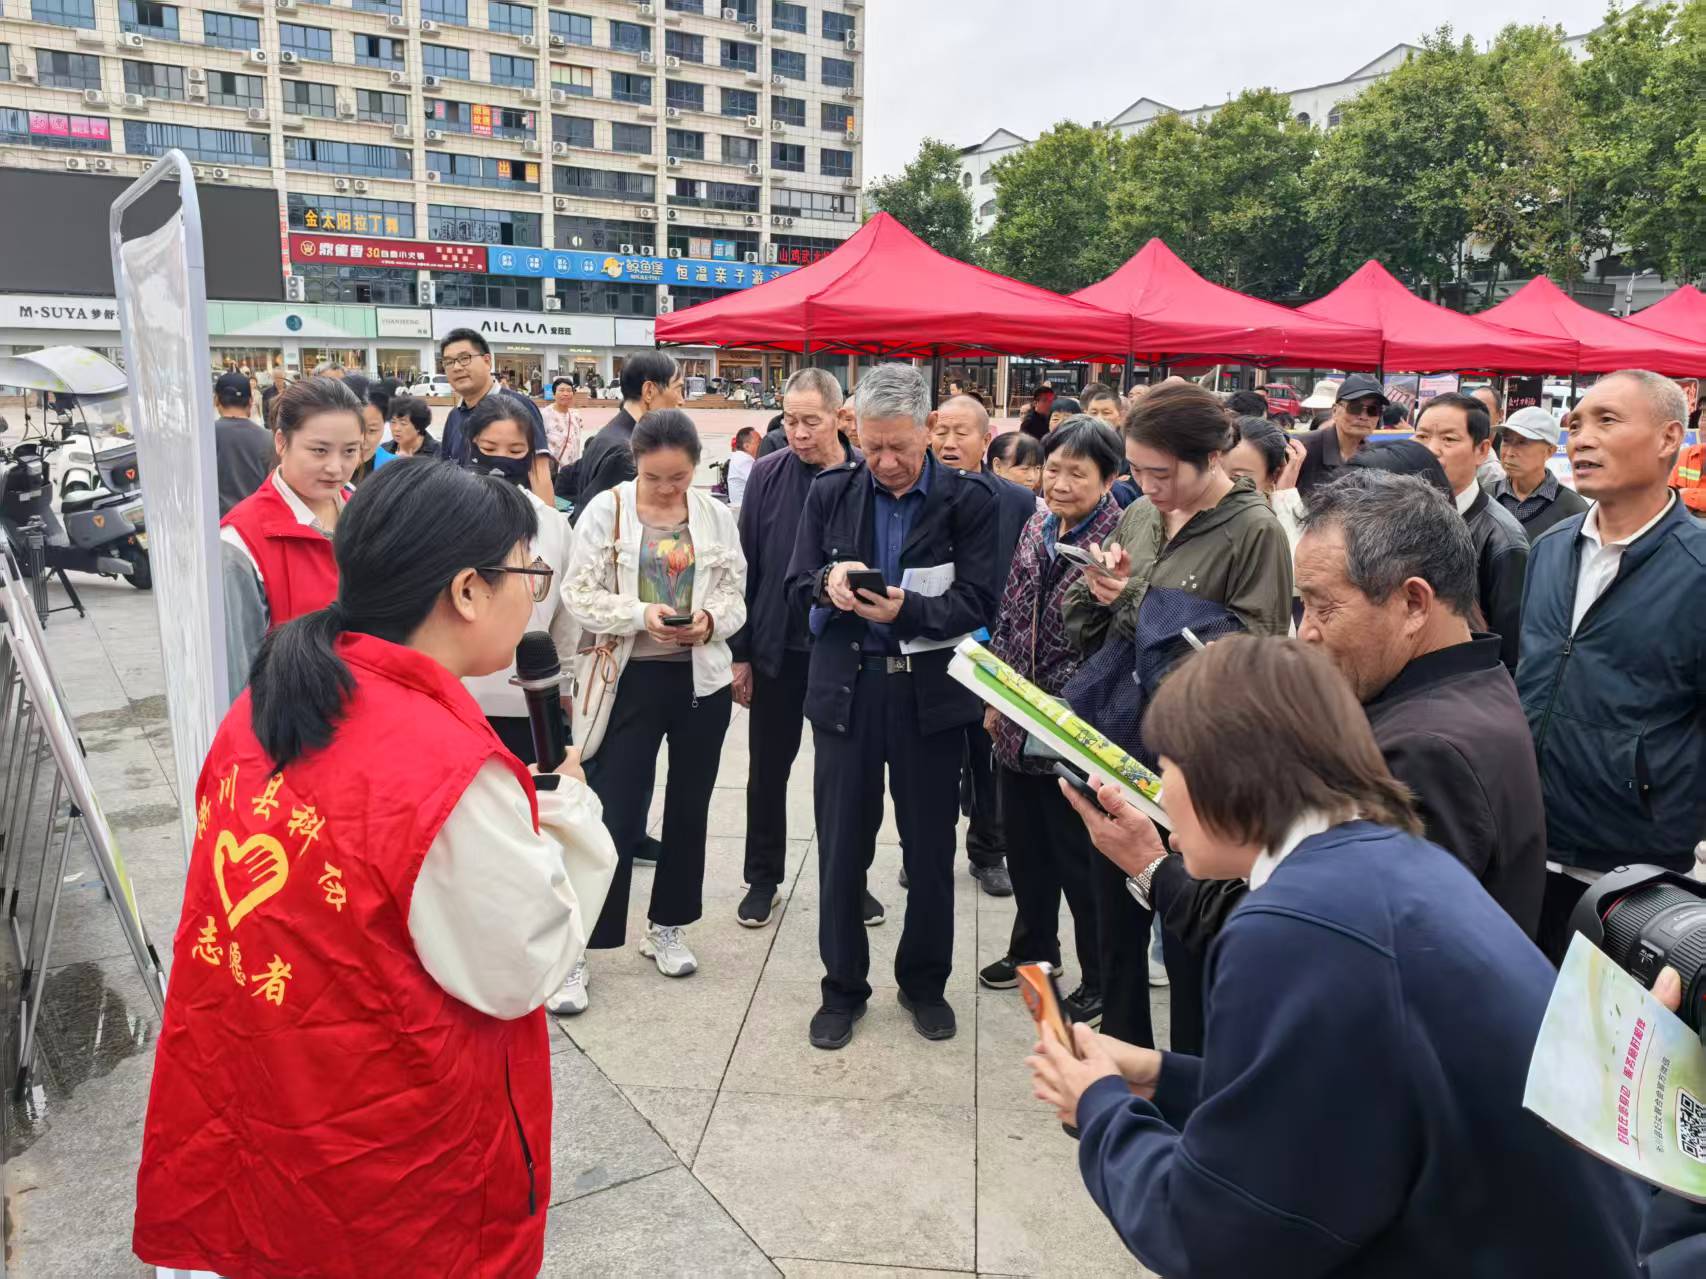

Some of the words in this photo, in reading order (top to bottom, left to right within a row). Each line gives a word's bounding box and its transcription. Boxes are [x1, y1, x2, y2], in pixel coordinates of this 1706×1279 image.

[626, 260, 664, 275] 鲸鱼堡
[91, 308, 120, 320] 梦舒
[481, 321, 548, 334] AILALA
[192, 916, 293, 1006] 志愿者
